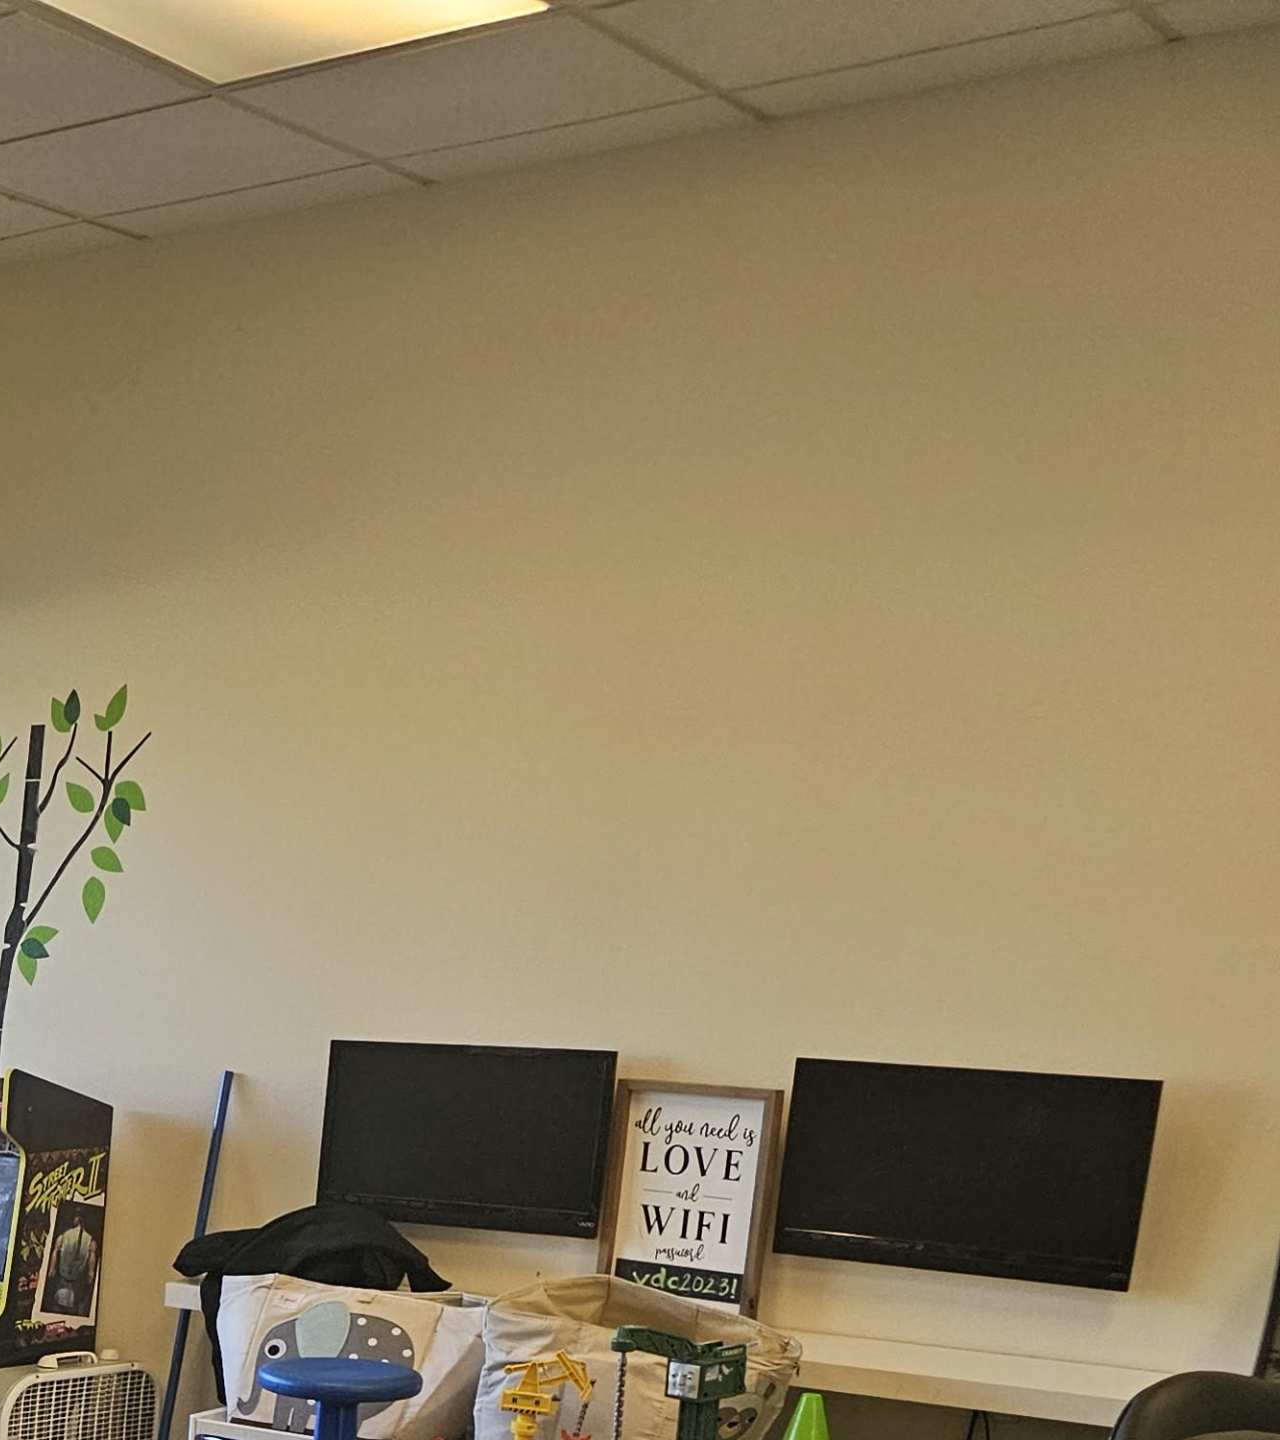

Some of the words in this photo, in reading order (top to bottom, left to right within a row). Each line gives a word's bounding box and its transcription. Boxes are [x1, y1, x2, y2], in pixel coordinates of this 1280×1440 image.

[635, 1107, 662, 1136] all
[665, 1120, 694, 1144] you
[700, 1114, 740, 1140] need
[743, 1128, 757, 1147] is
[83, 1152, 107, 1200] II
[640, 1142, 743, 1182] LOVE
[25, 1161, 70, 1213] STREET
[676, 1183, 700, 1202] and
[642, 1203, 731, 1244] WIFI
[655, 1245, 704, 1261] password
